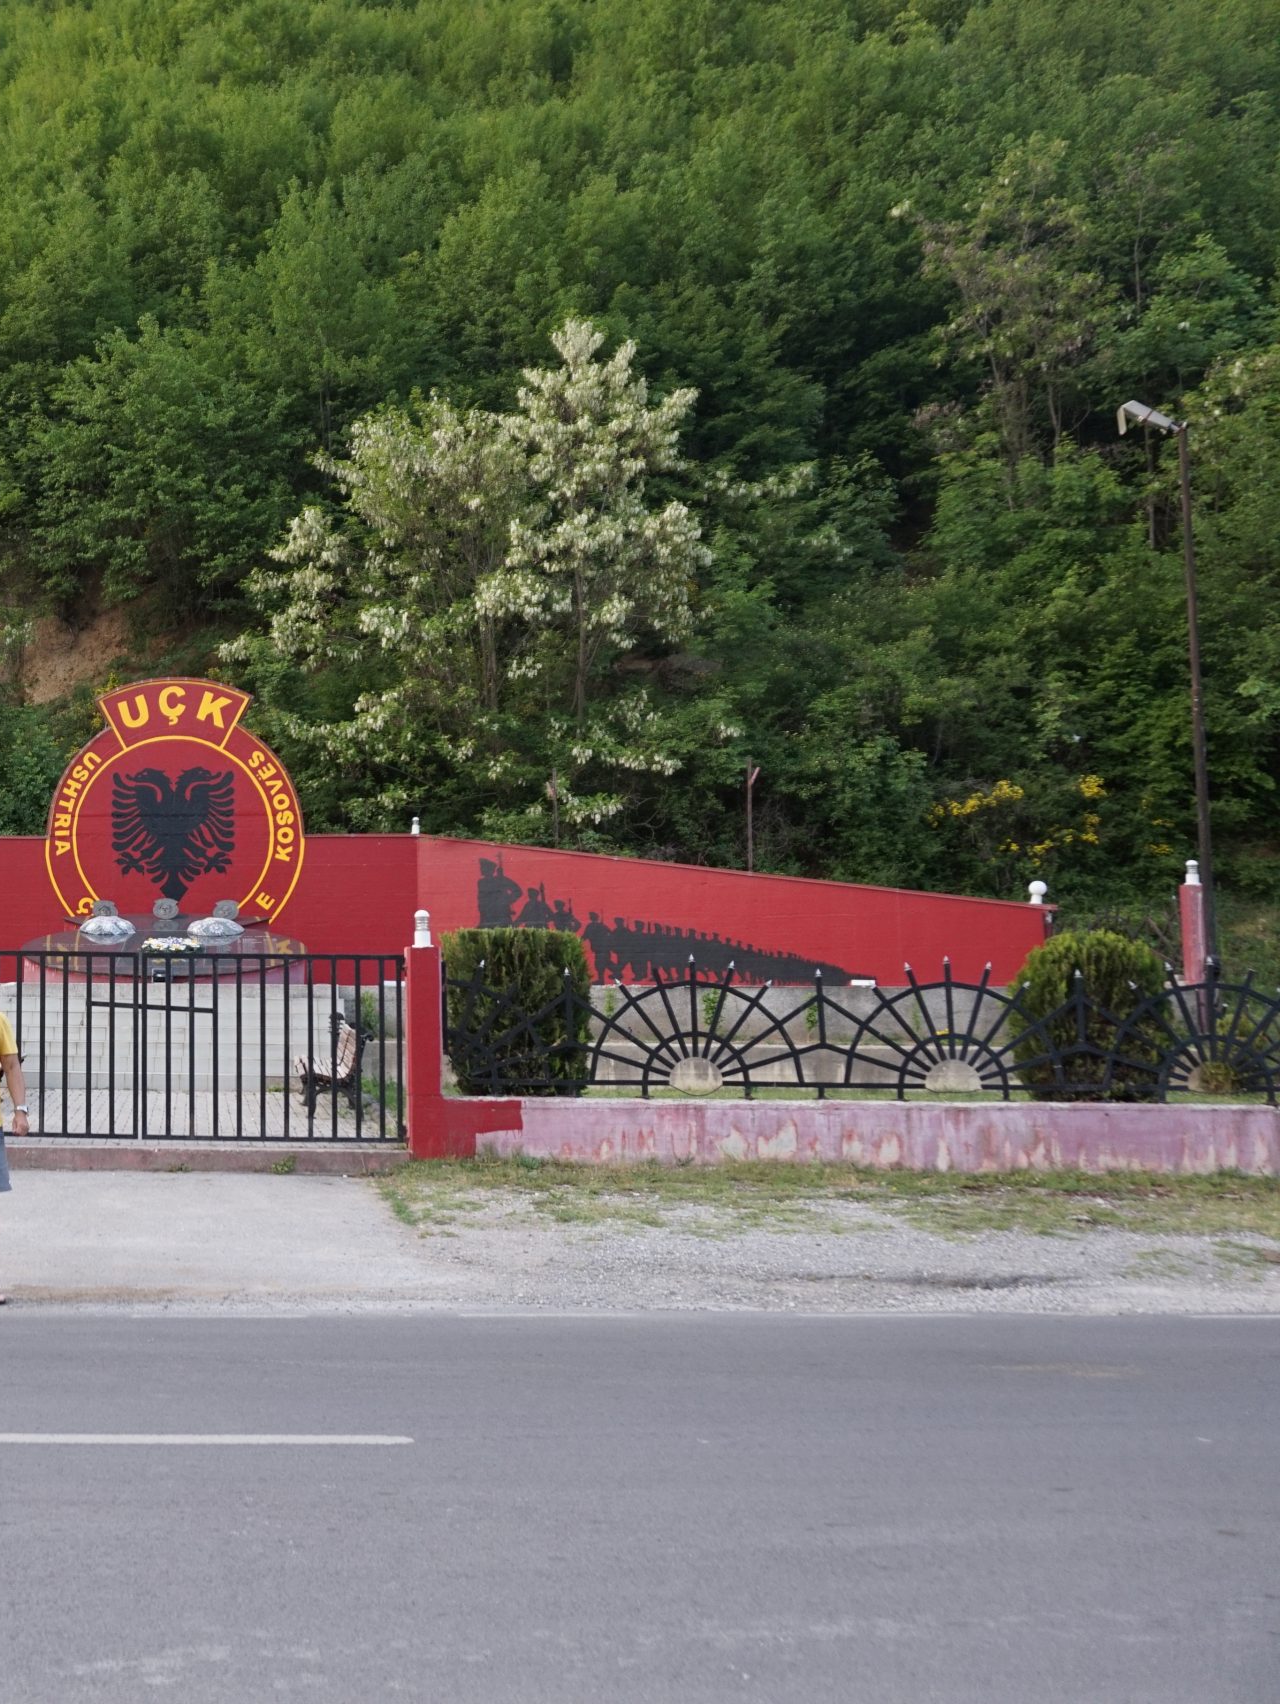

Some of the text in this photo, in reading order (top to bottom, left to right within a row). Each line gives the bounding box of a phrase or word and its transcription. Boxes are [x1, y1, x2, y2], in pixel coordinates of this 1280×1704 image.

[117, 685, 233, 729] UÇK
[54, 751, 102, 856] USHTRIA
[248, 750, 295, 862] KOSOVËS
